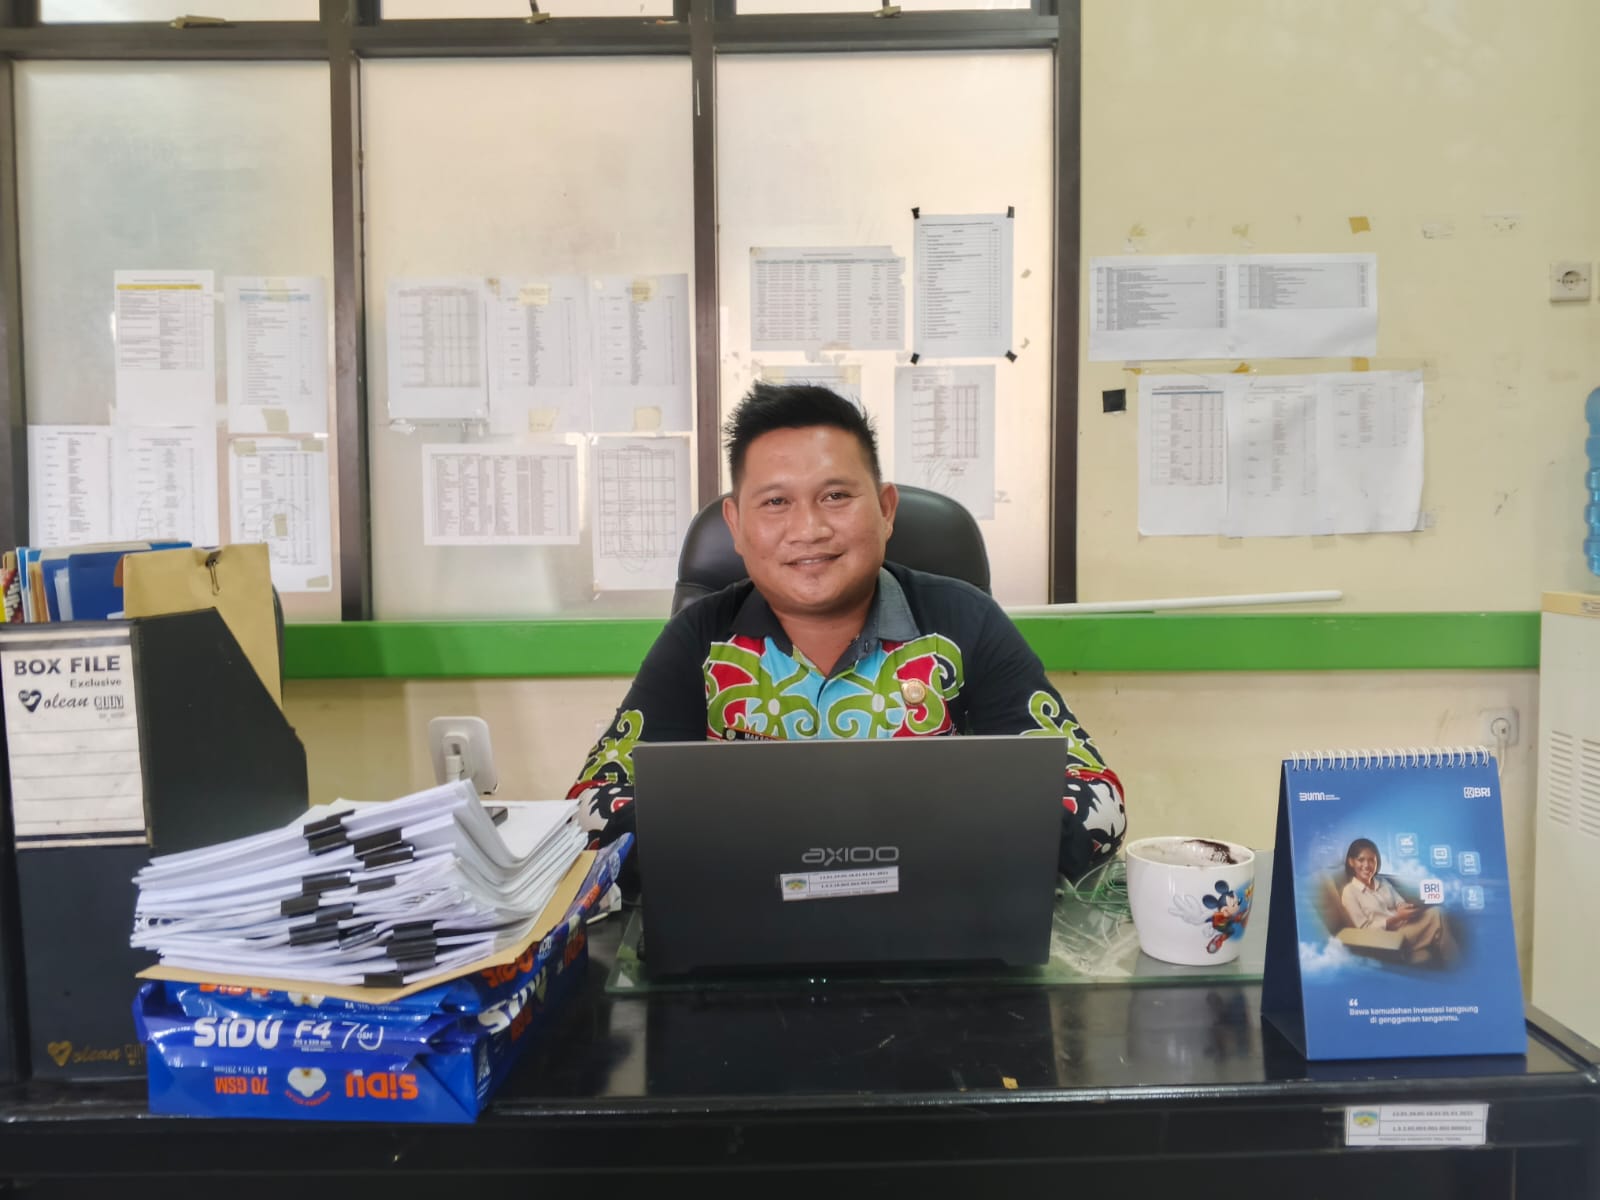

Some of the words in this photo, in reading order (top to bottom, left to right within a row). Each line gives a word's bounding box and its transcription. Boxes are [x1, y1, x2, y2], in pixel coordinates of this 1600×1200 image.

[14, 658, 61, 676] BOX
[70, 655, 121, 673] FILE
[70, 678, 122, 688] Exclusive
[1474, 787, 1491, 798] BRI
[1424, 883, 1440, 893] BRI
[1370, 1007, 1412, 1015] kemudahan
[1370, 1016, 1377, 1024] di
[1379, 1016, 1421, 1025] genggaman
[295, 1020, 333, 1041] F4
[214, 1076, 247, 1094] GSM
[251, 1076, 269, 1094] 70
